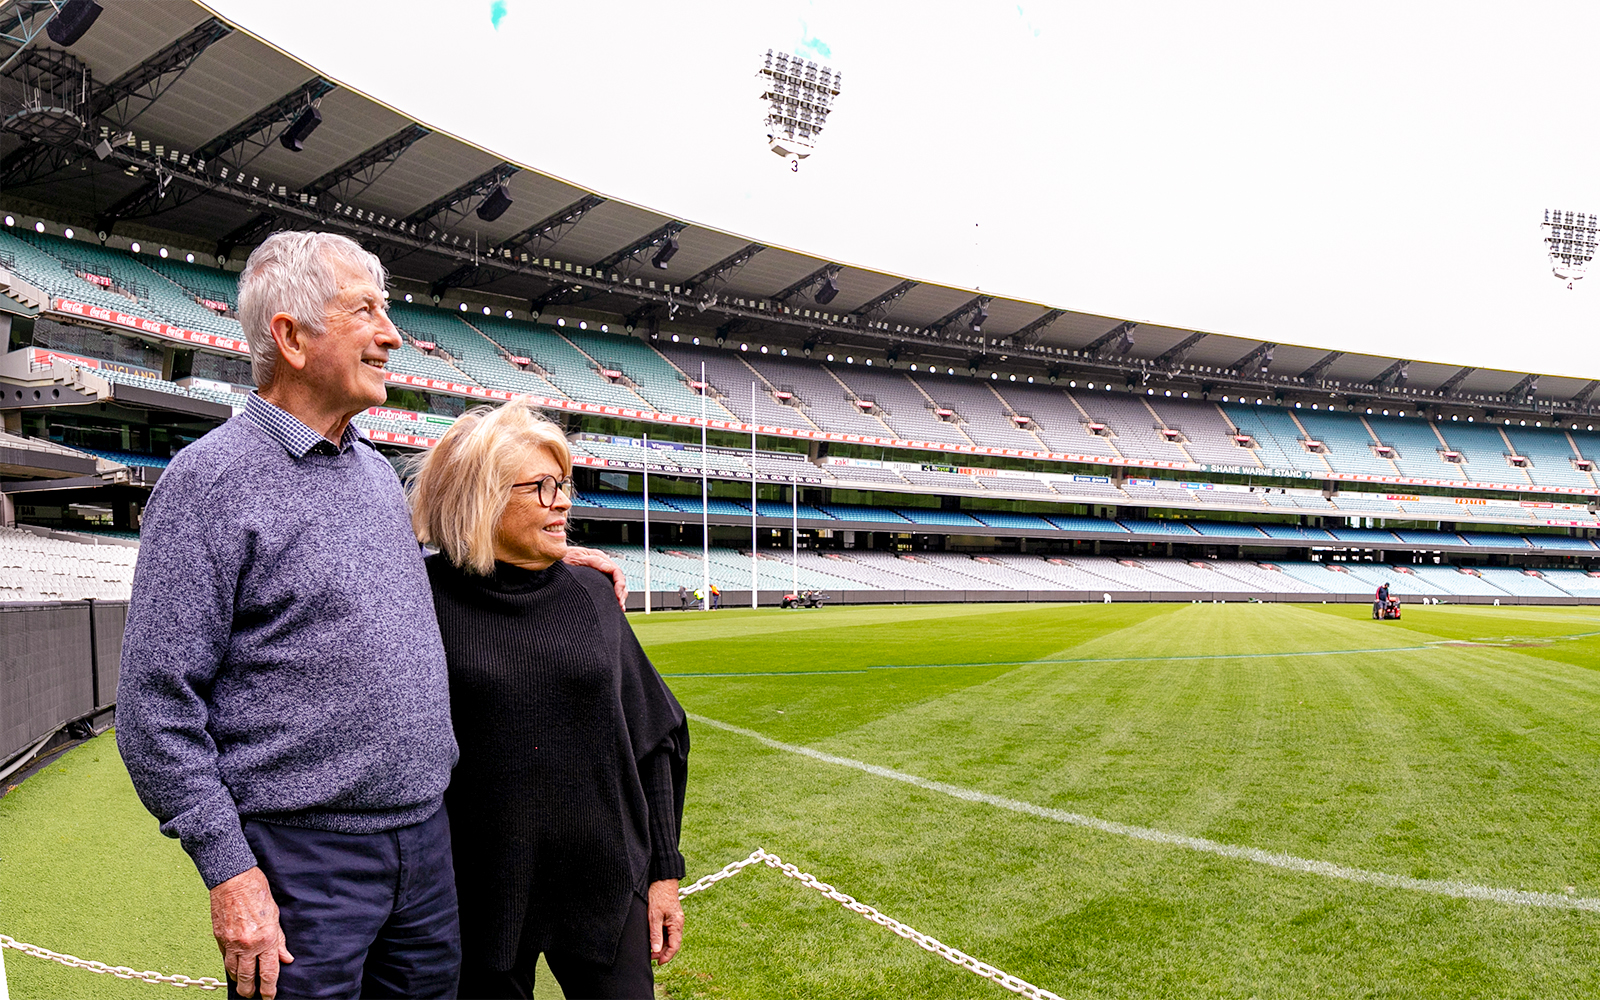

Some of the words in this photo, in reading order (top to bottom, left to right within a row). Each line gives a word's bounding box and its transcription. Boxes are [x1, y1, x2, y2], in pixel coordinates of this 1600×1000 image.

[791, 160, 798, 172] 3
[1210, 465, 1240, 474] SHANE
[1242, 466, 1273, 476] WARNE
[1274, 469, 1302, 478] STAND
[21, 506, 36, 515] BAR
